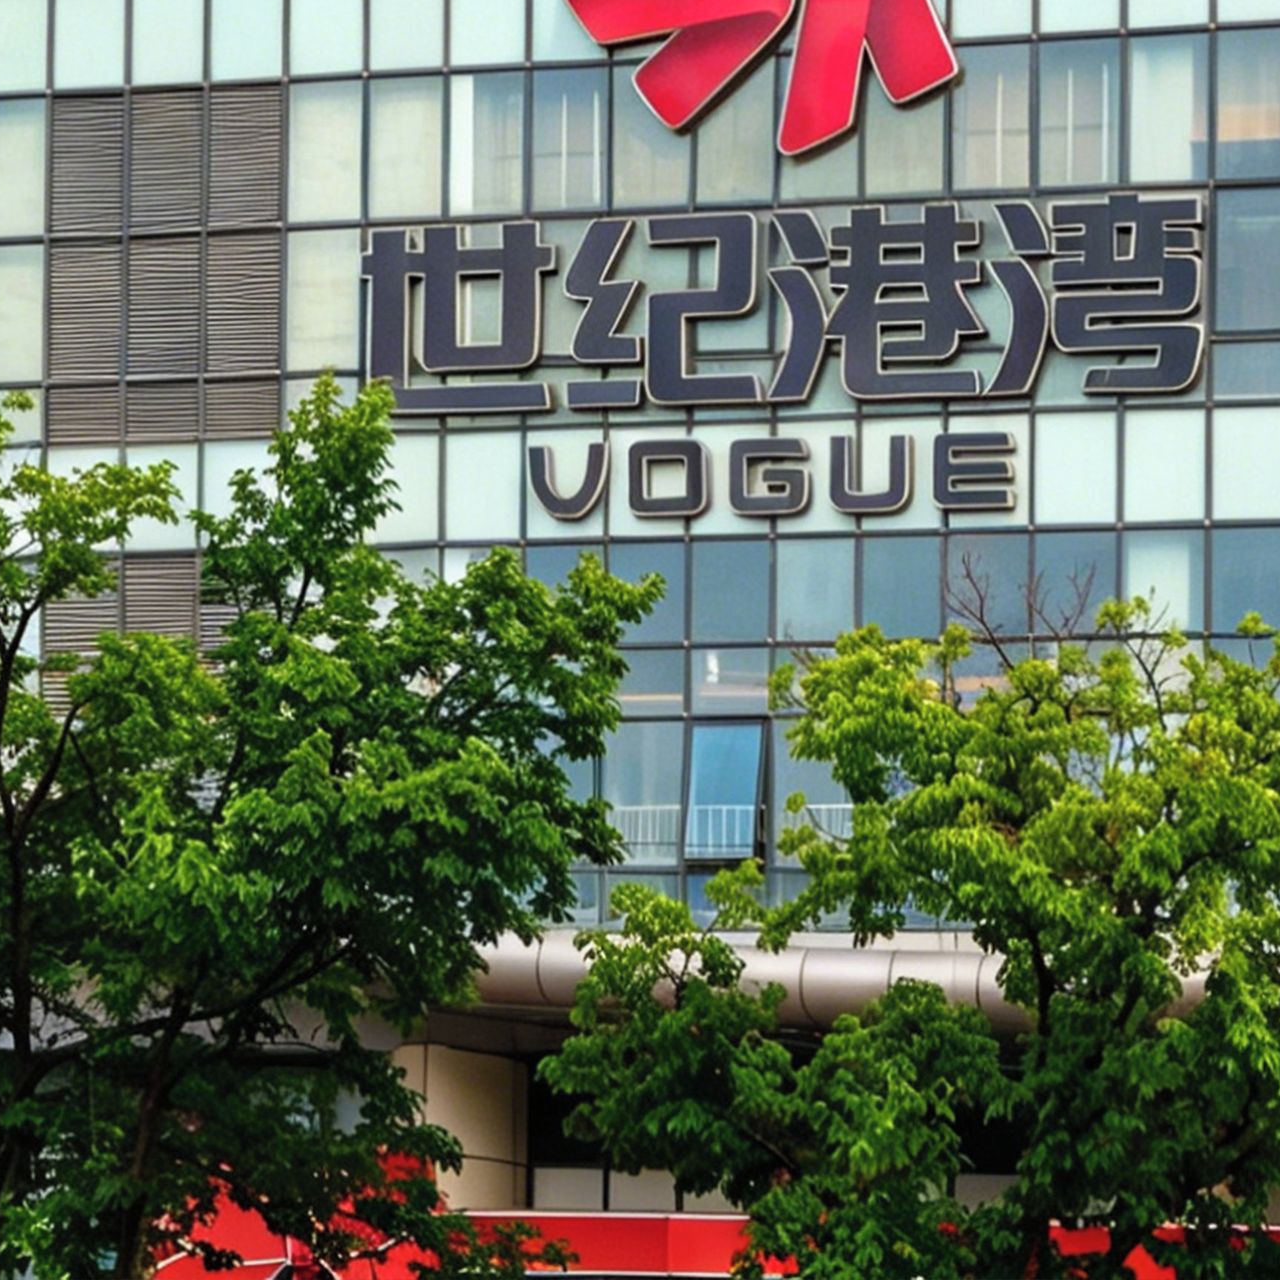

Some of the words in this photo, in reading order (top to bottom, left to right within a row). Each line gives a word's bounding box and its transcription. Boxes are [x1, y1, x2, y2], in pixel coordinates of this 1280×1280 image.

[361, 193, 1206, 414] 世纪港湾
[527, 431, 1017, 521] VOGUE
